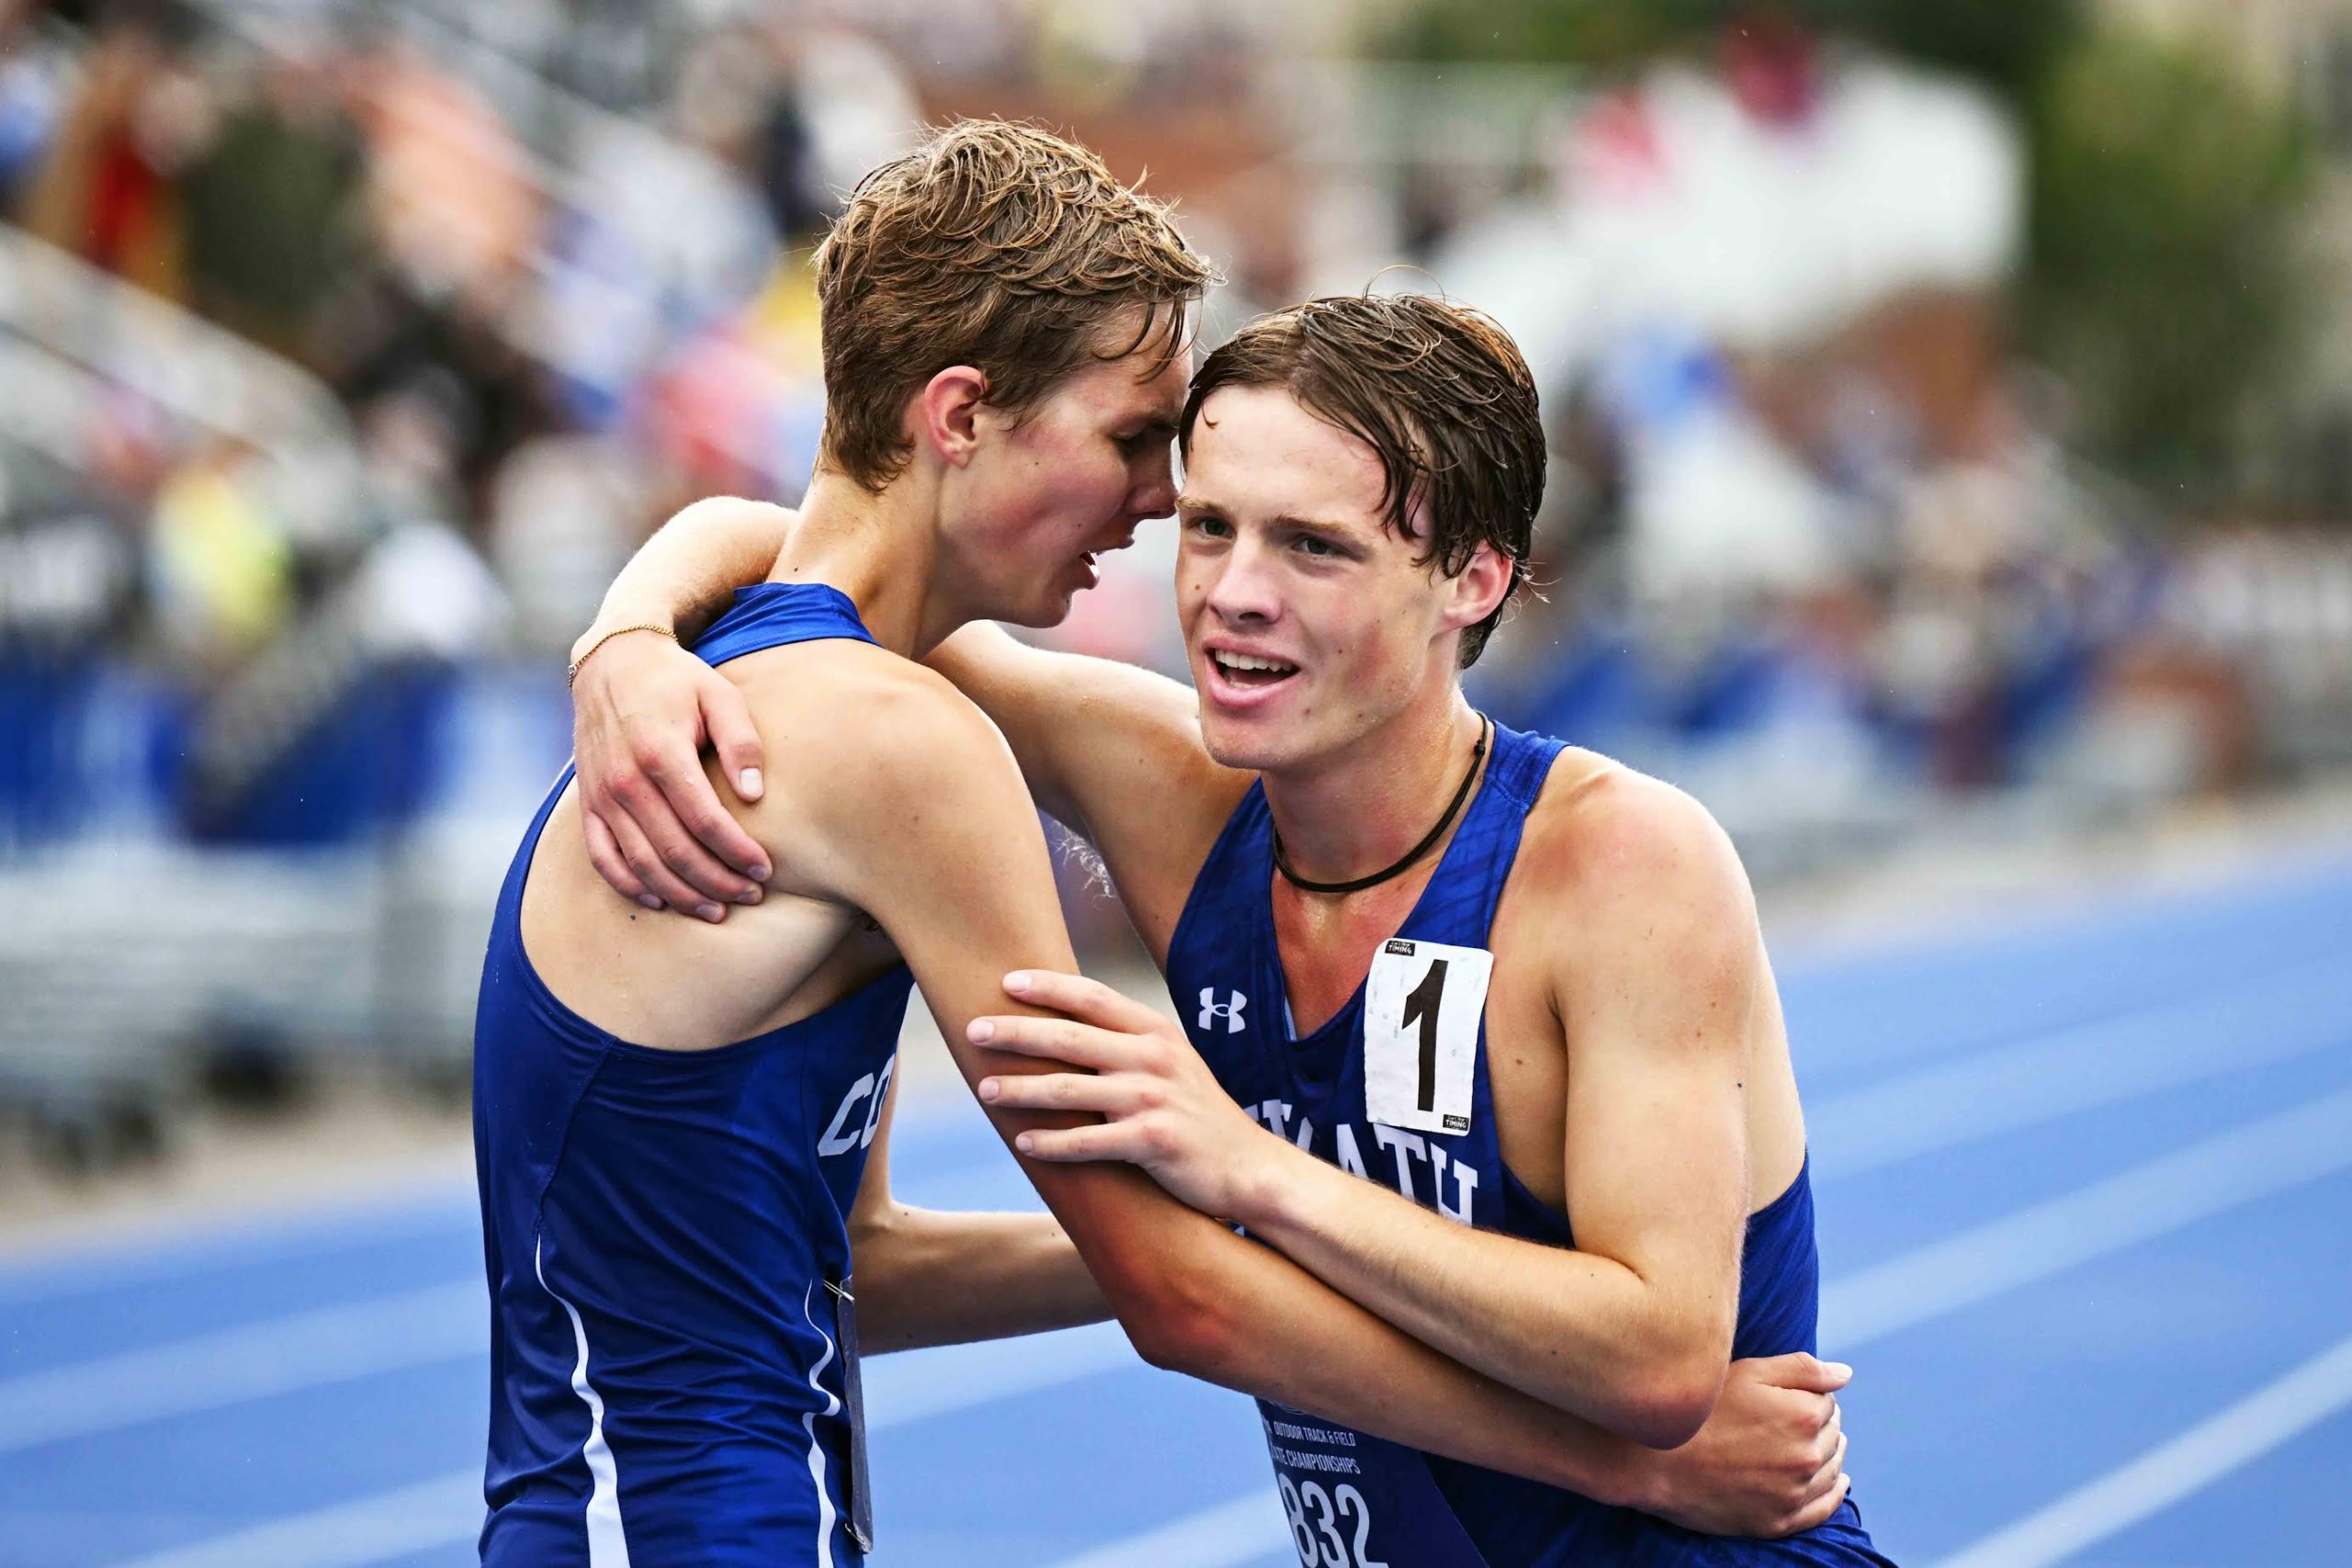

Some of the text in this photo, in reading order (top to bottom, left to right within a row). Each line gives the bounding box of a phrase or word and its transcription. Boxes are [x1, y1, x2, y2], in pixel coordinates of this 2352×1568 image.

[1388, 944, 1412, 954] TIMING
[1402, 959, 1449, 1112] 1
[1445, 1119, 1467, 1129] TIMING
[1273, 1420, 1305, 1440] OUTDOOR
[1303, 1427, 1329, 1443] TRACK
[1333, 1431, 1357, 1447] FIELD
[1286, 1450, 1362, 1474] CHAMPIONSHIPS
[1278, 1472, 1390, 1568] 832
